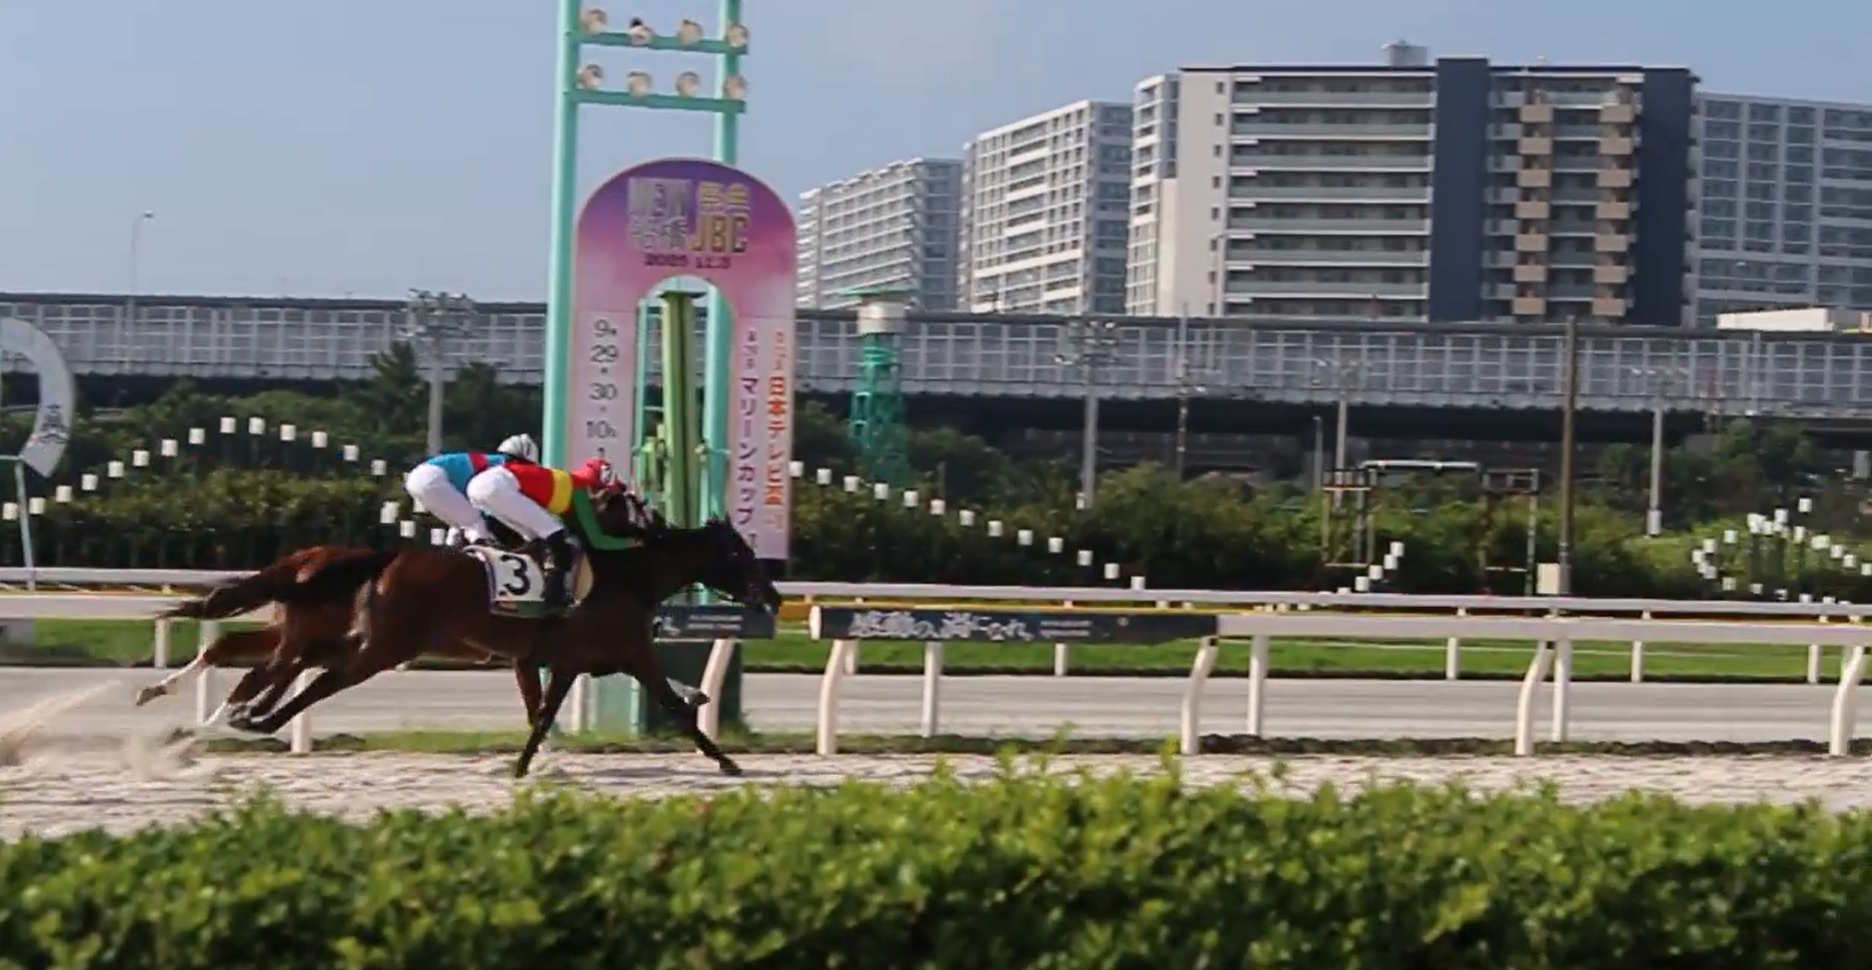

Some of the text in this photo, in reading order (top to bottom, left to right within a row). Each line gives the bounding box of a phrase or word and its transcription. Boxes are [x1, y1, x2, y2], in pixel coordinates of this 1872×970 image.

[690, 214, 748, 253] JBC
[590, 344, 618, 363] 29
[589, 382, 618, 400] 30
[500, 554, 531, 596] 3
